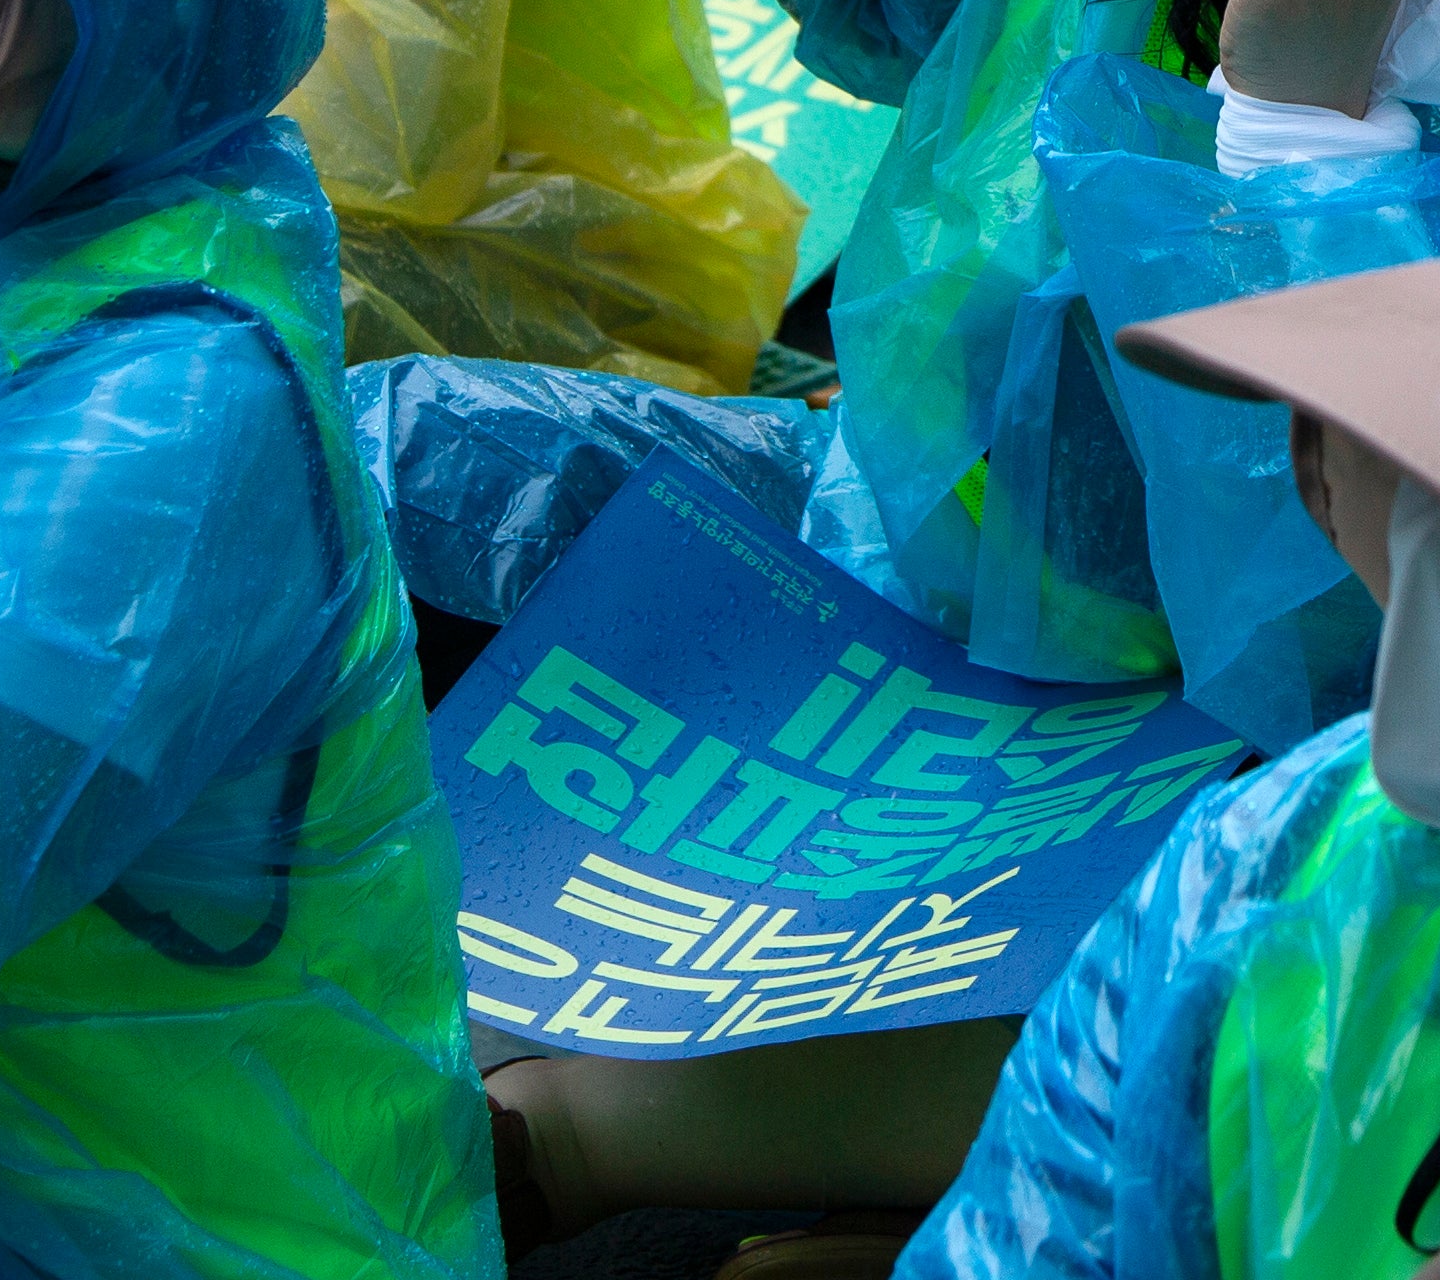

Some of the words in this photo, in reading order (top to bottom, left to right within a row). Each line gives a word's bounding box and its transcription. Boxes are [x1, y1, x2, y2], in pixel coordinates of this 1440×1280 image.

[646, 480, 819, 607] 전국보건의료산업노동조합
[464, 644, 1246, 900] 산별총파업
[769, 640, 1169, 793] 승리!
[554, 852, 1022, 974] 지키는
